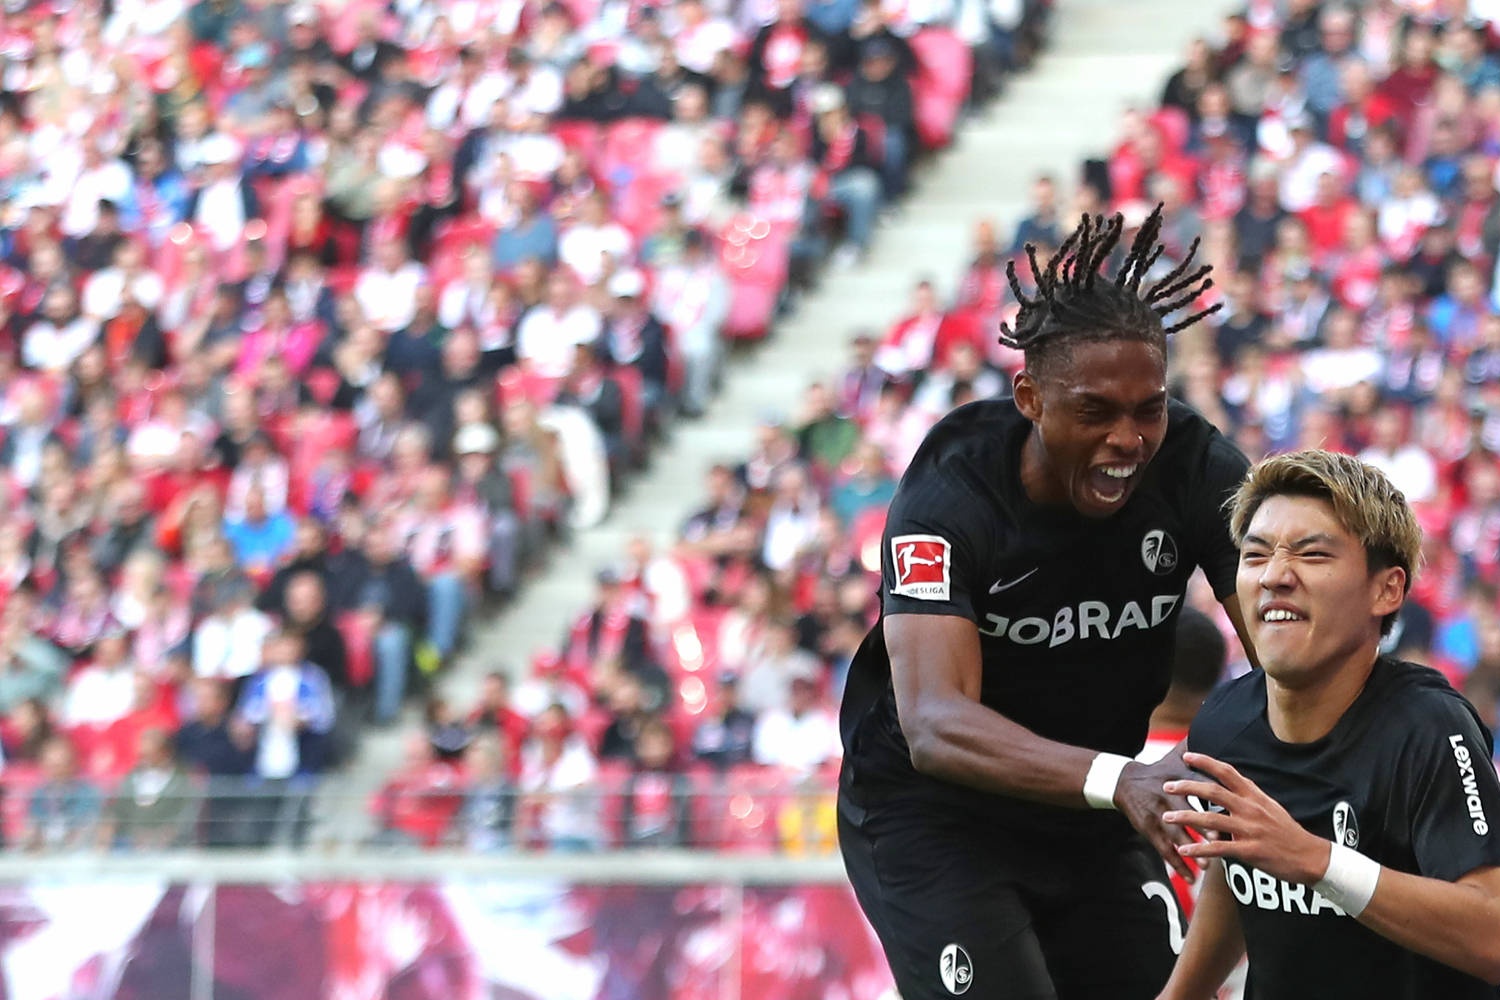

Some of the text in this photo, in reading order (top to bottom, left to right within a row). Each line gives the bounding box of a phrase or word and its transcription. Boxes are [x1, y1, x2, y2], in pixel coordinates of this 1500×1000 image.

[978, 595, 1181, 648] JOBRAD
[1448, 734, 1489, 836] Lexware
[1221, 858, 1347, 916] OBRA
